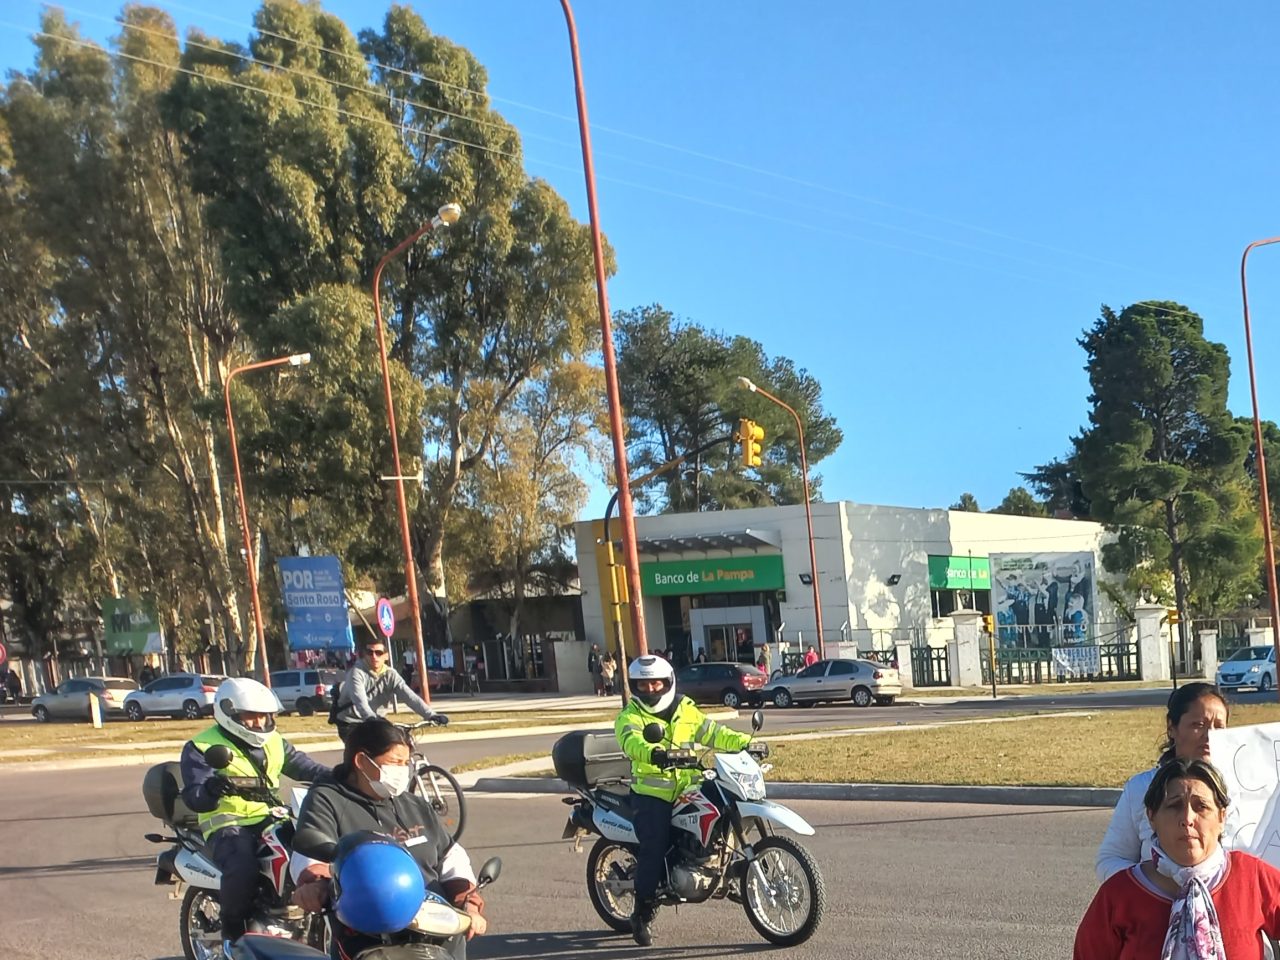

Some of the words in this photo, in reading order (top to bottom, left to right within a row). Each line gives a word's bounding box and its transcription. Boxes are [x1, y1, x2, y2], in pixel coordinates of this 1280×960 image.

[283, 570, 314, 589] POR
[655, 572, 685, 585] Banco
[686, 570, 700, 583] de
[701, 570, 715, 582] La
[717, 568, 755, 582] Pampa
[287, 593, 315, 605] Santa
[316, 593, 340, 605] Rosa
